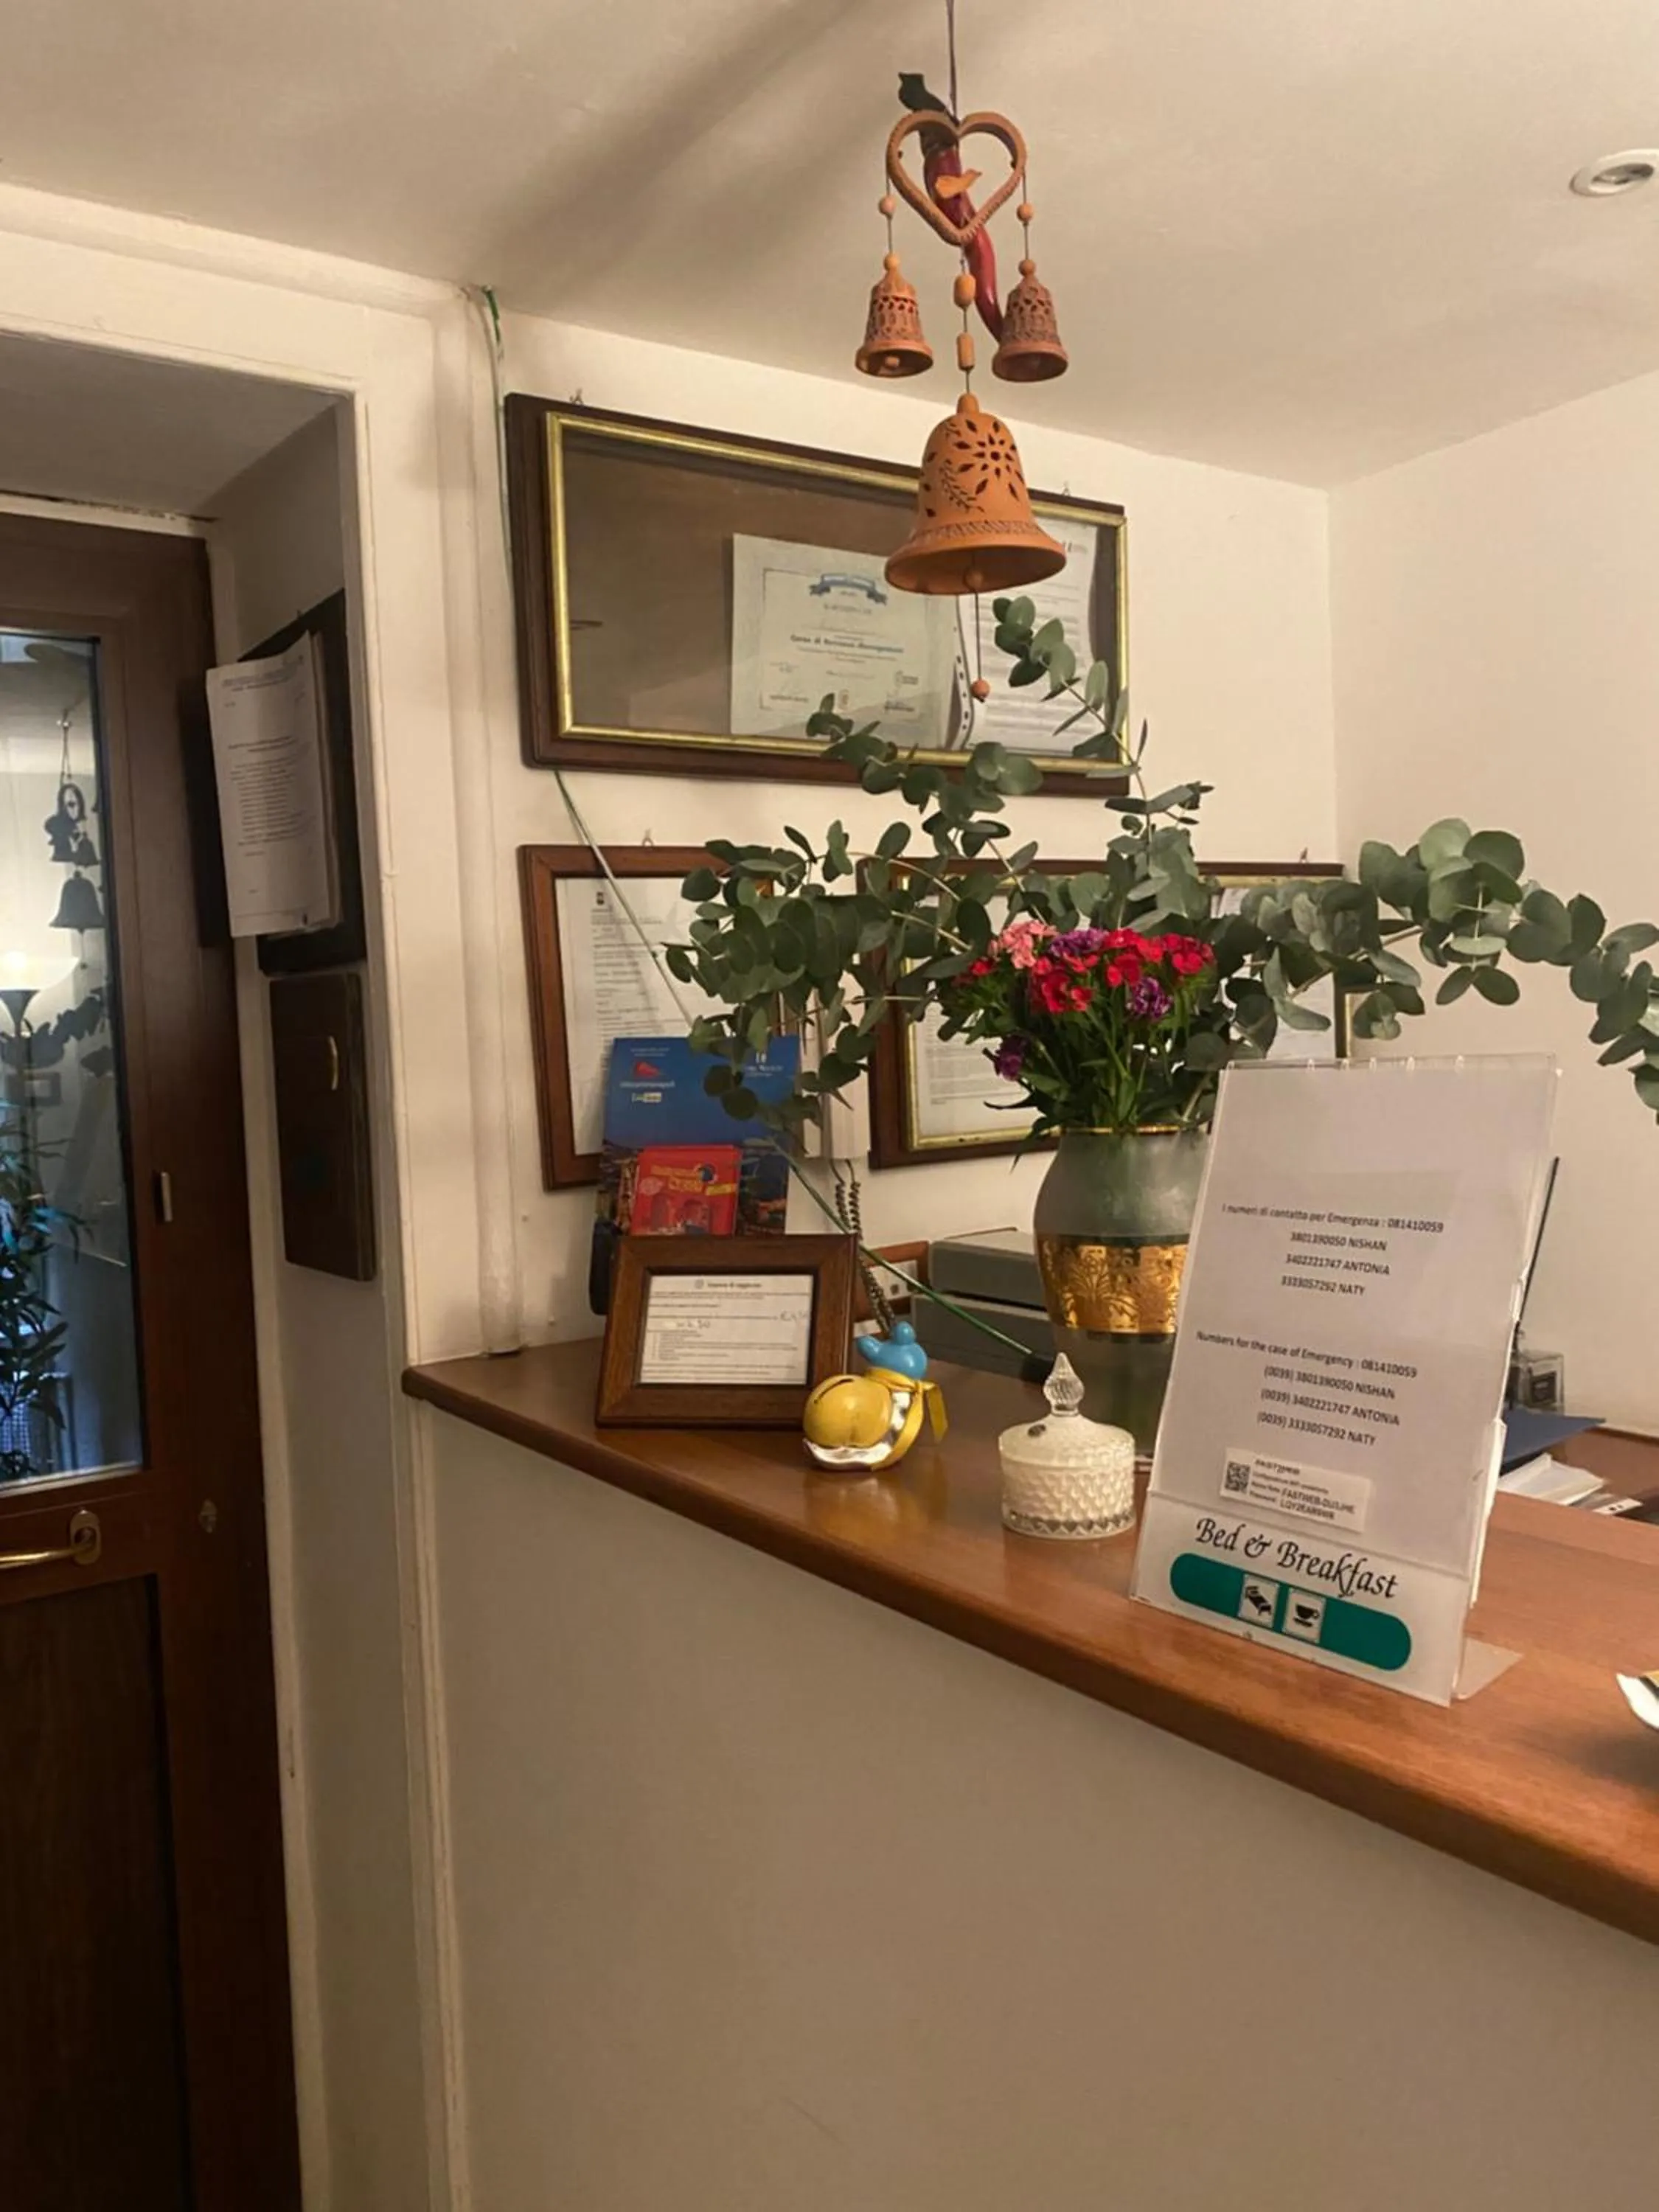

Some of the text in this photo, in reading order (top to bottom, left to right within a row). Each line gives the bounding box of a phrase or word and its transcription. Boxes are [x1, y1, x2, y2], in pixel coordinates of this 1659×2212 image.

[1309, 1213, 1326, 1222] per
[1348, 1237, 1388, 1251] NISHAN
[1342, 1259, 1390, 1276] ANTONIA
[1338, 1282, 1366, 1296] NATY
[1236, 1336, 1250, 1348] for
[1251, 1340, 1267, 1352] the
[1267, 1344, 1288, 1356] case
[1290, 1346, 1301, 1357] of
[1301, 1348, 1354, 1369] Emergency
[1355, 1381, 1396, 1399] NISHAN
[1351, 1405, 1400, 1427] ANTONIA
[1347, 1430, 1377, 1446] NATY
[1196, 1517, 1399, 1599] Bed & Breakfast
